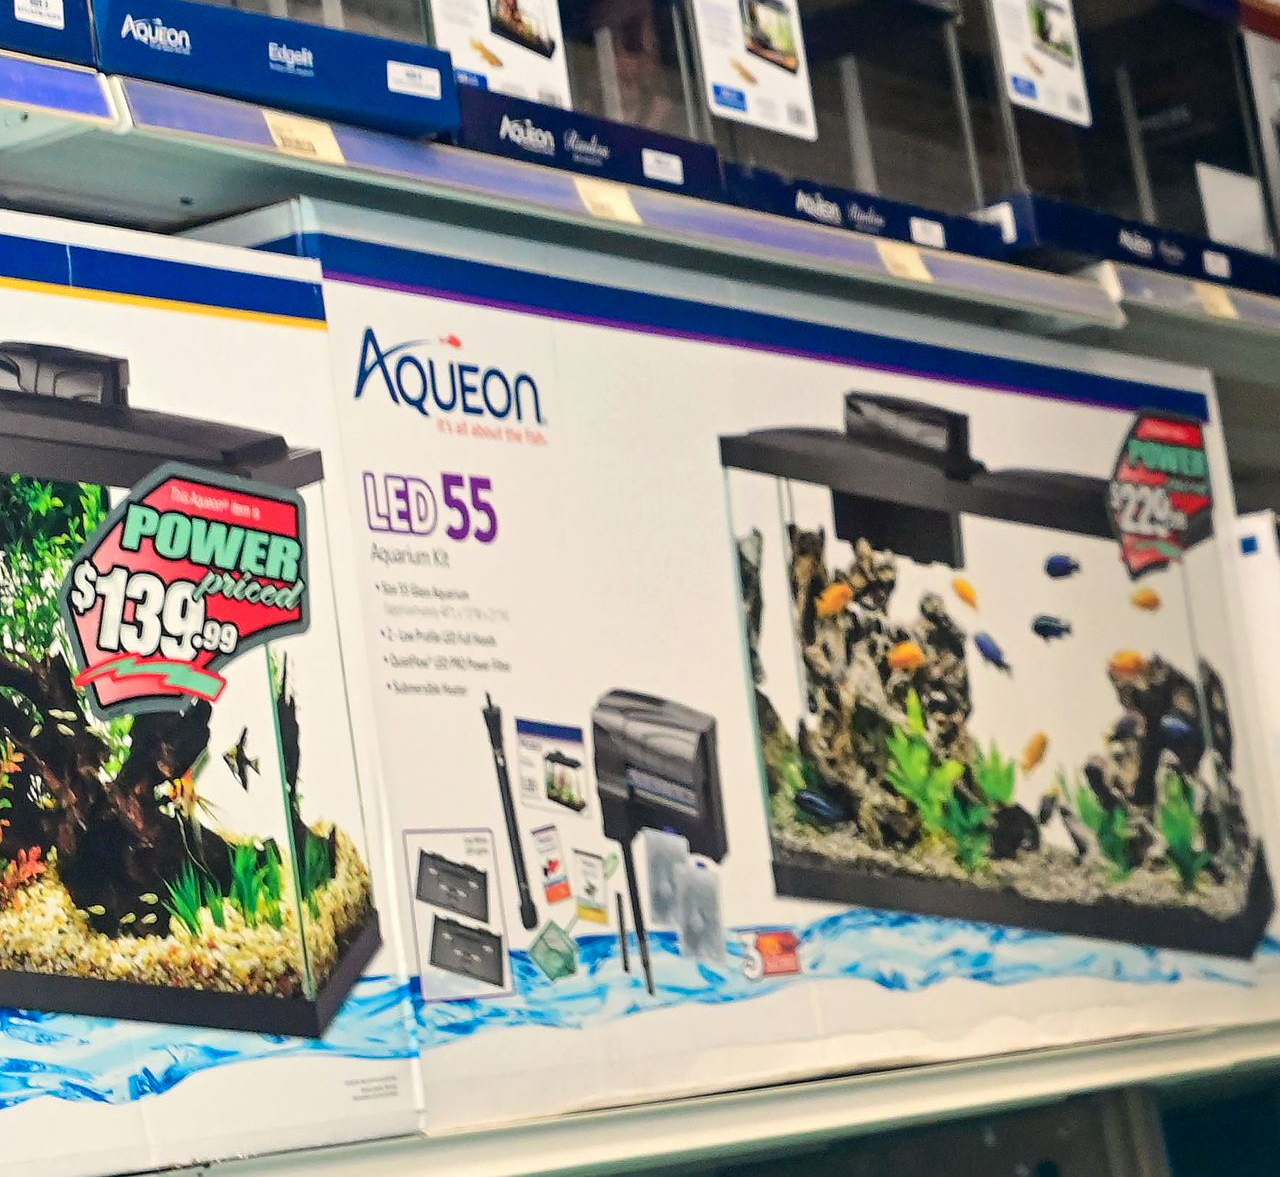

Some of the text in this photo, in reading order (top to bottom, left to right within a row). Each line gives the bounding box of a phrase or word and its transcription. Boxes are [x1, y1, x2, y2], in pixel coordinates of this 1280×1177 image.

[268, 41, 314, 69] Edgelit
[354, 325, 542, 424] AQUEON
[1128, 437, 1209, 479] POWER
[169, 485, 189, 504] This
[362, 470, 498, 544] LED 55
[120, 503, 303, 583] POWER
[370, 541, 451, 569] Aquarium Kit
[192, 570, 306, 611] priced
